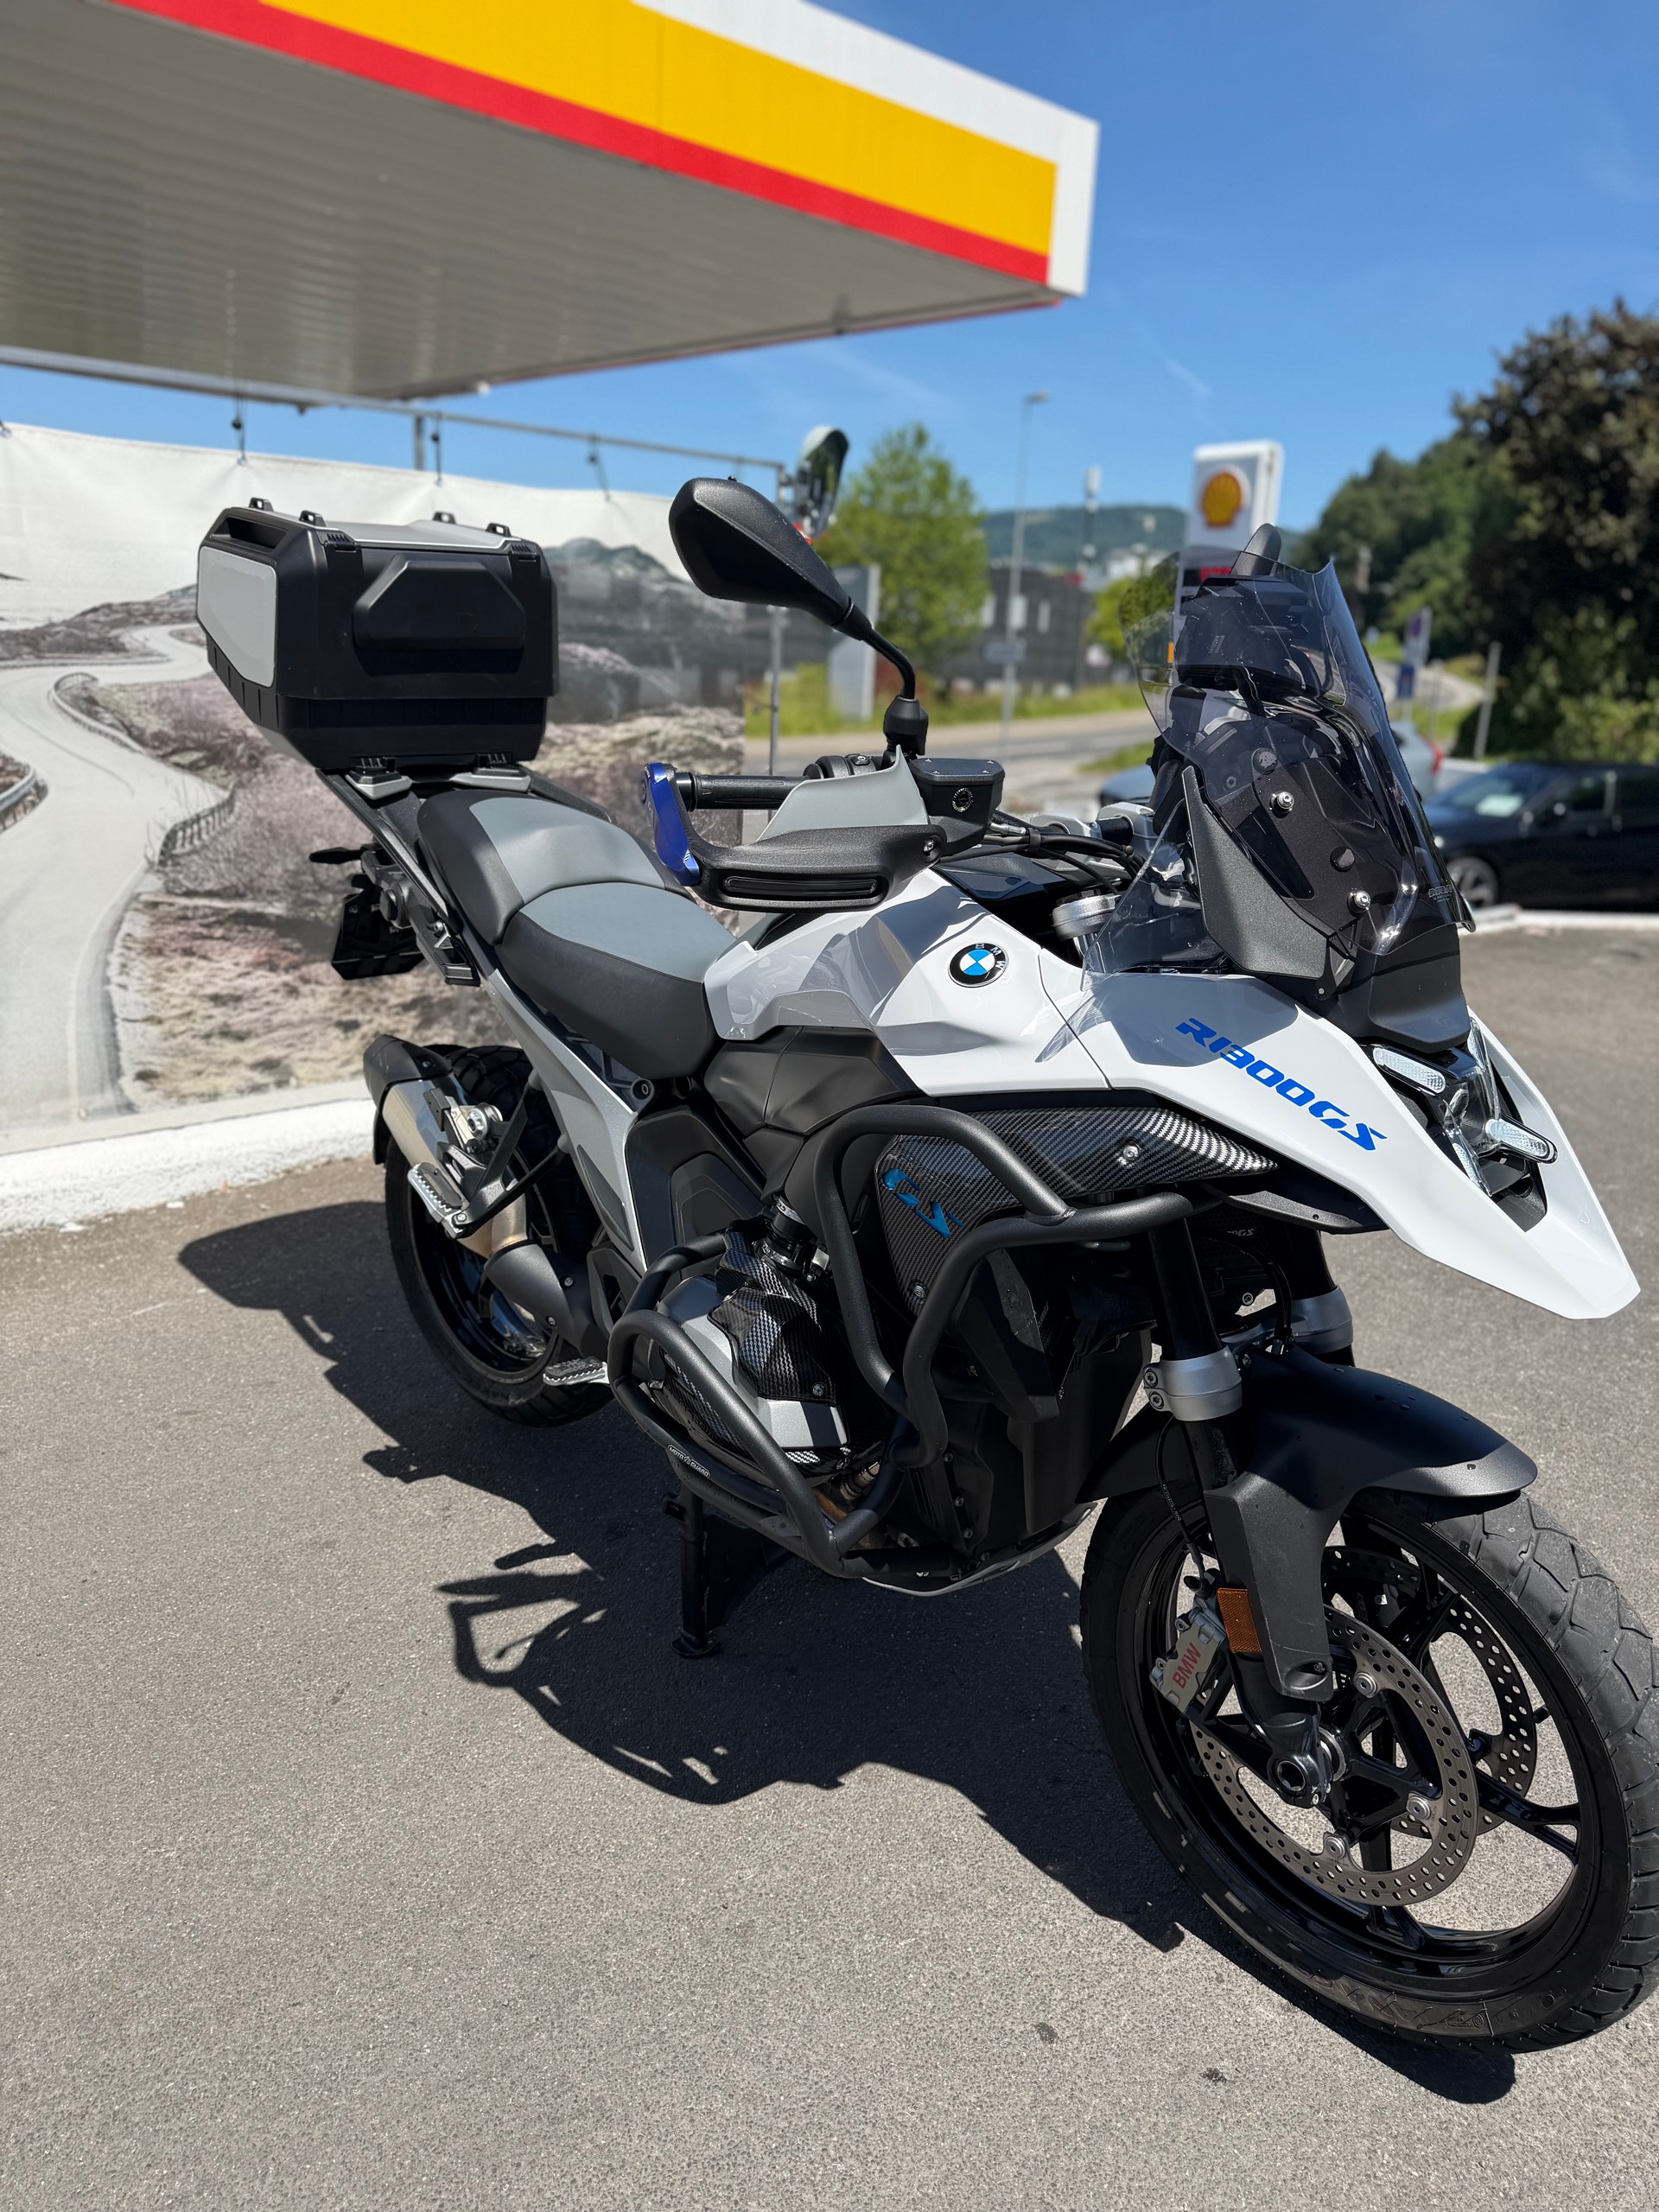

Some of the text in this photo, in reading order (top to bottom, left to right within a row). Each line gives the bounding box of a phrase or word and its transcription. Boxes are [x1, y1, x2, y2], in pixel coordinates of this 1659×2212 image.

[1175, 1018, 1388, 1151] R1300GS
[690, 1461, 709, 1478] GUARD
[1172, 1642, 1202, 1689] BMW
